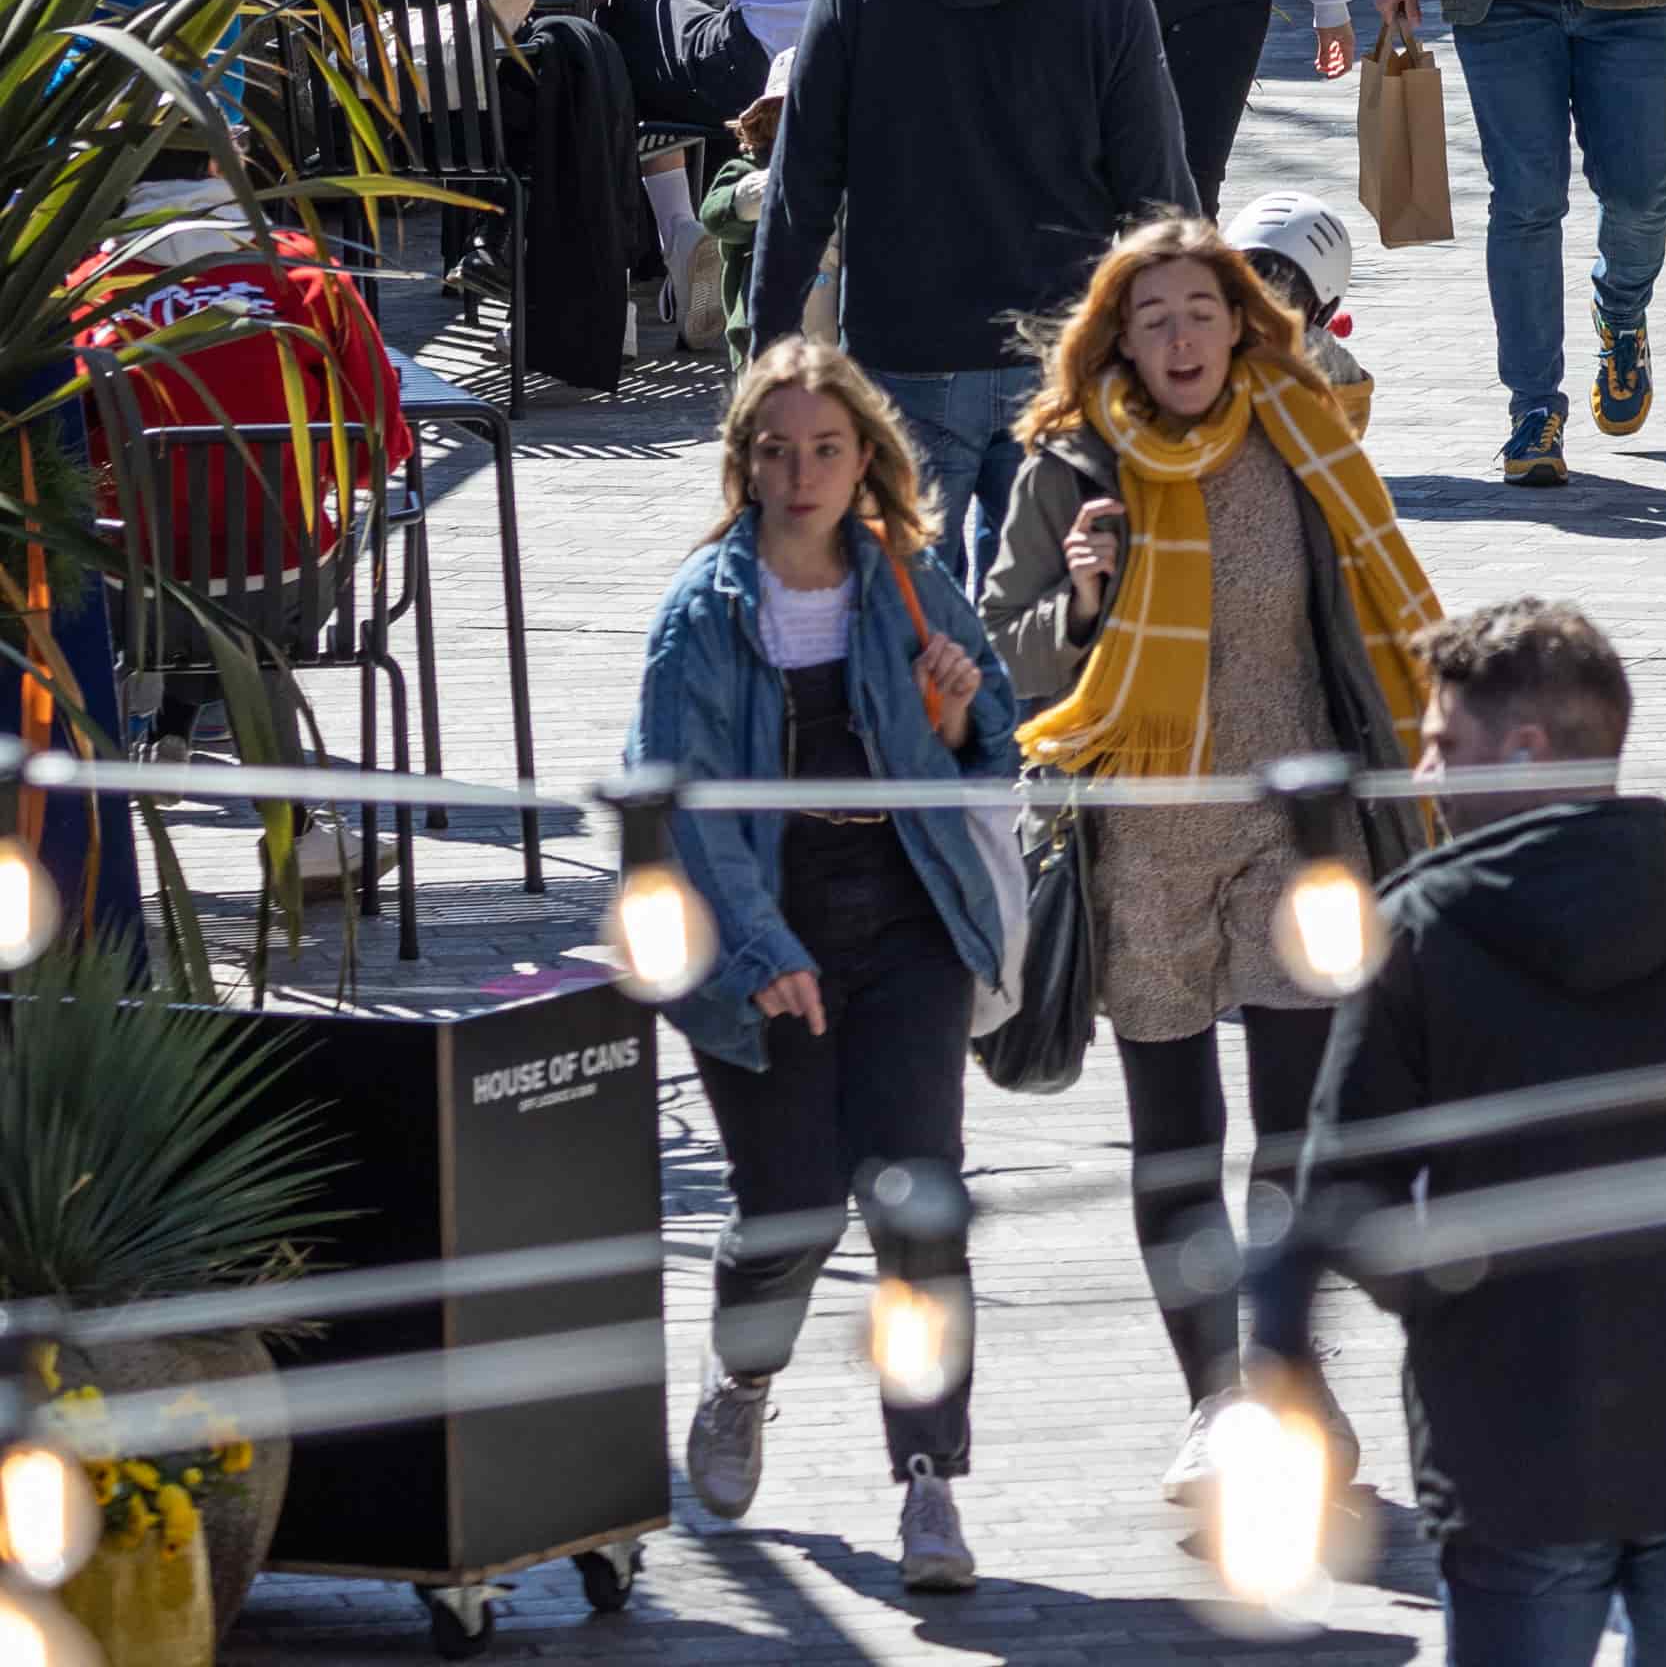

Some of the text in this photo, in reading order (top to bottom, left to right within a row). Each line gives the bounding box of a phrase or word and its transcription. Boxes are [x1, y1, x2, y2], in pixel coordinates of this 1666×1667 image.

[472, 1059, 547, 1104] HOUSE
[548, 1051, 579, 1085] OF
[581, 1037, 640, 1076] CANS
